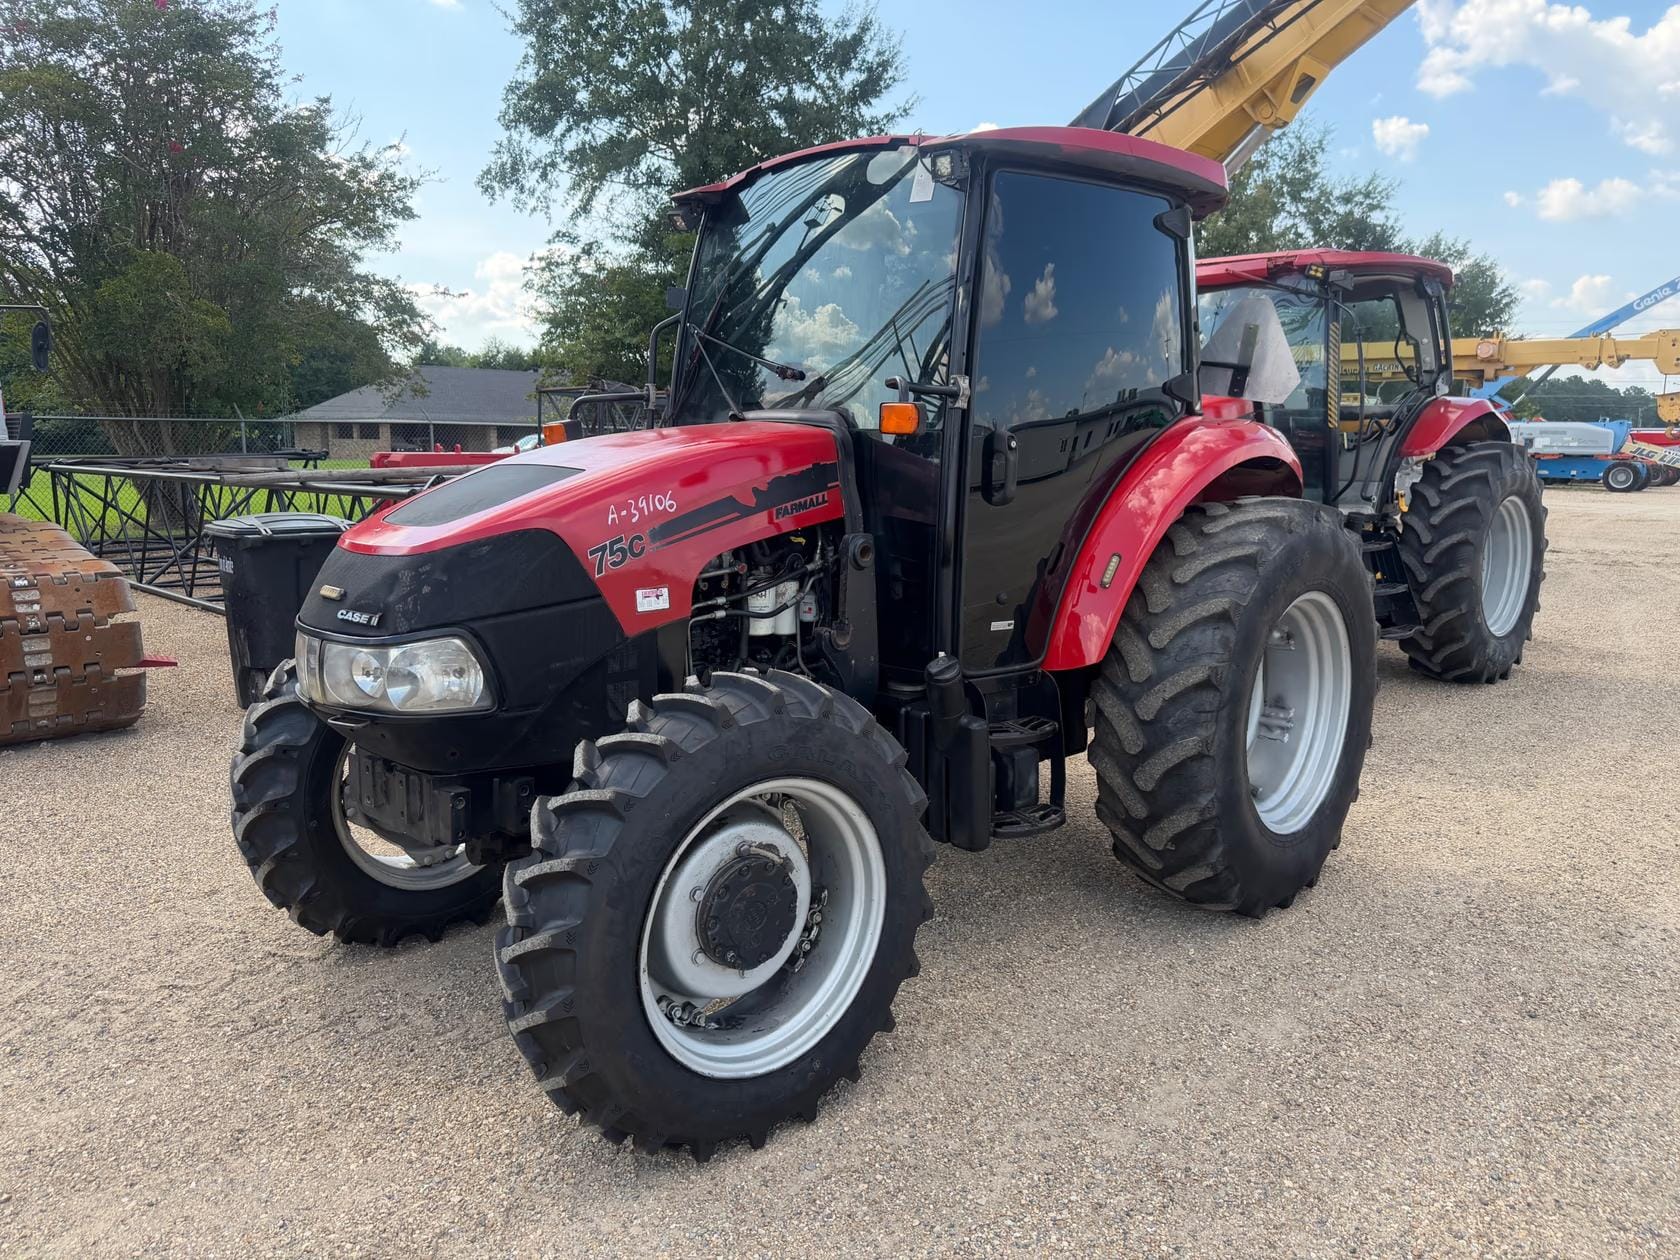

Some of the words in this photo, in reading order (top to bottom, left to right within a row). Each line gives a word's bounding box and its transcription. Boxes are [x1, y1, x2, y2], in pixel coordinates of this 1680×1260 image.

[1632, 287, 1673, 310] Genie
[1629, 447, 1659, 459] JLG
[607, 490, 677, 526] A-39106
[774, 493, 829, 520] FARMALL
[587, 533, 647, 578] 75C
[336, 609, 370, 624] CASE
